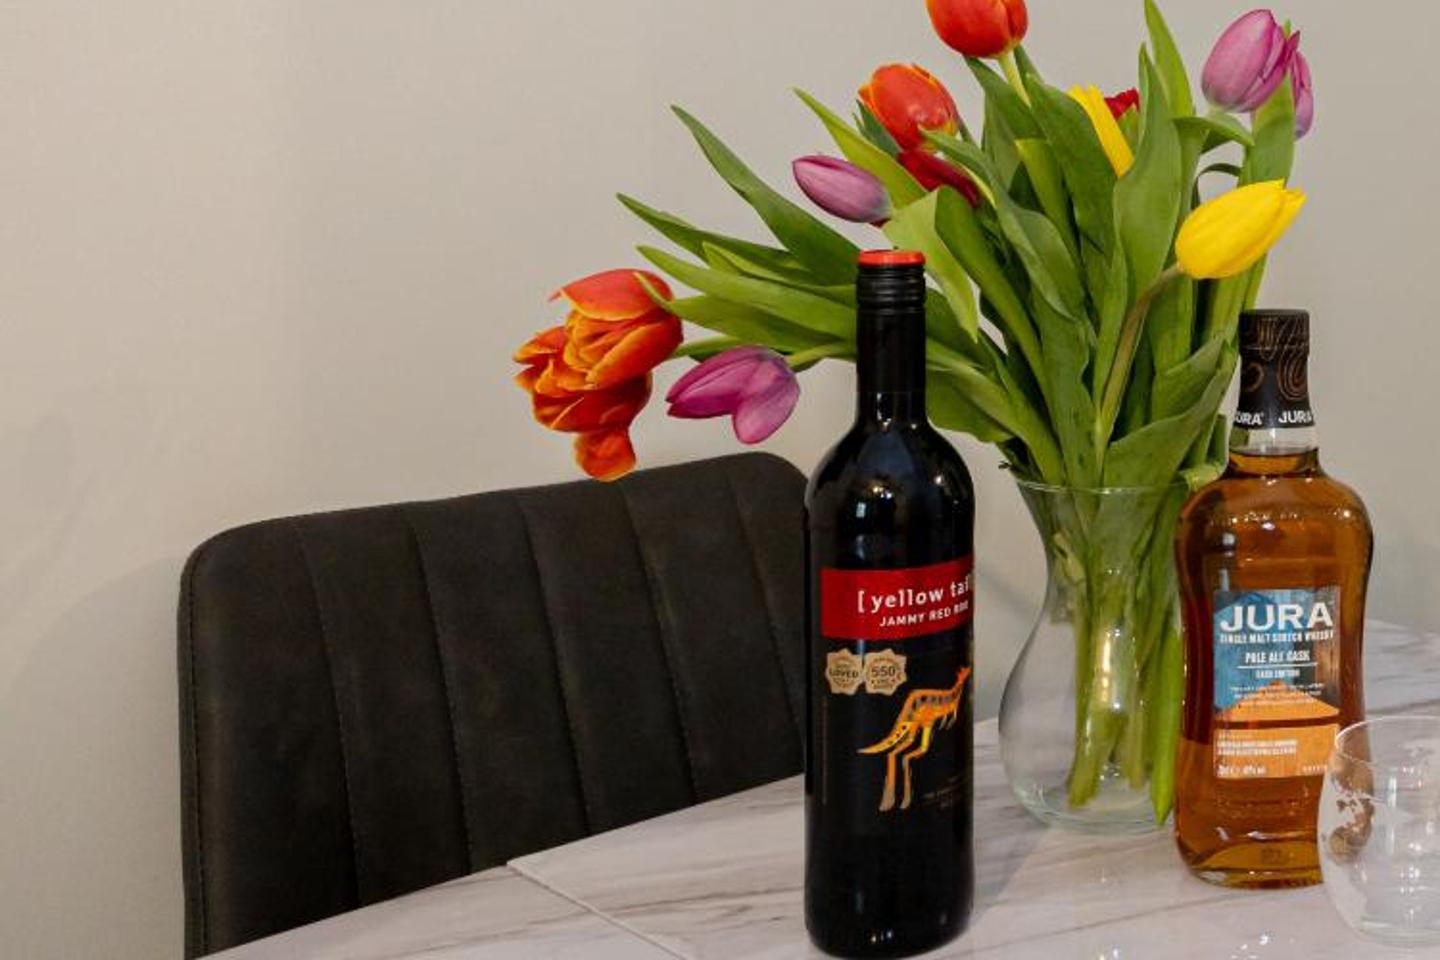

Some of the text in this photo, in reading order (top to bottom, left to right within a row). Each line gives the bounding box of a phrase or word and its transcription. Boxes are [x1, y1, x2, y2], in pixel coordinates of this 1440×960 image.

[1235, 411, 1263, 426] URA
[880, 613, 926, 628] JAMMY
[929, 607, 952, 621] RED
[1220, 601, 1334, 632] JURA
[1249, 632, 1271, 644] MALT
[1286, 649, 1311, 662] CASK
[871, 665, 896, 678] 550
